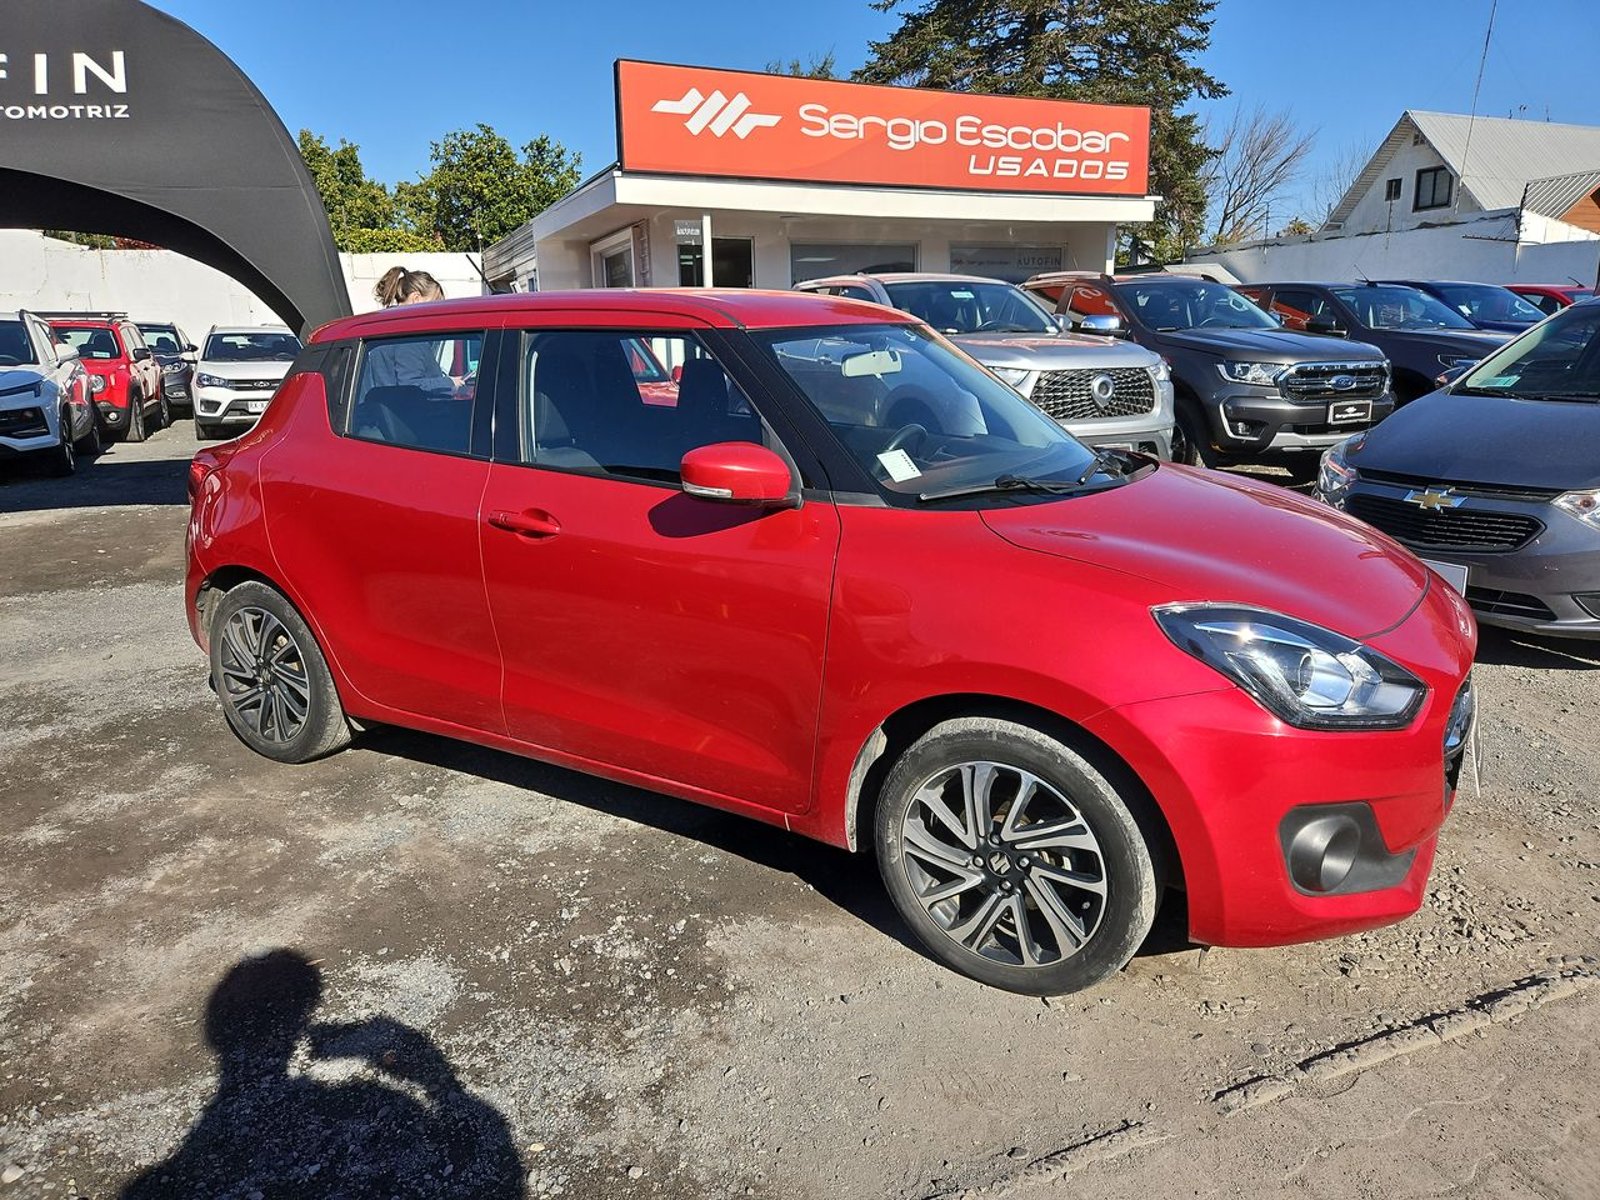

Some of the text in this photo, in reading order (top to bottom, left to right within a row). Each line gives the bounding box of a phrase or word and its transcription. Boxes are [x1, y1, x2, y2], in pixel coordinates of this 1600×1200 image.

[798, 103, 1130, 153] Sergio Escobar
[968, 154, 1130, 180] USADOS
[1018, 257, 1060, 266] AUTOFIN
